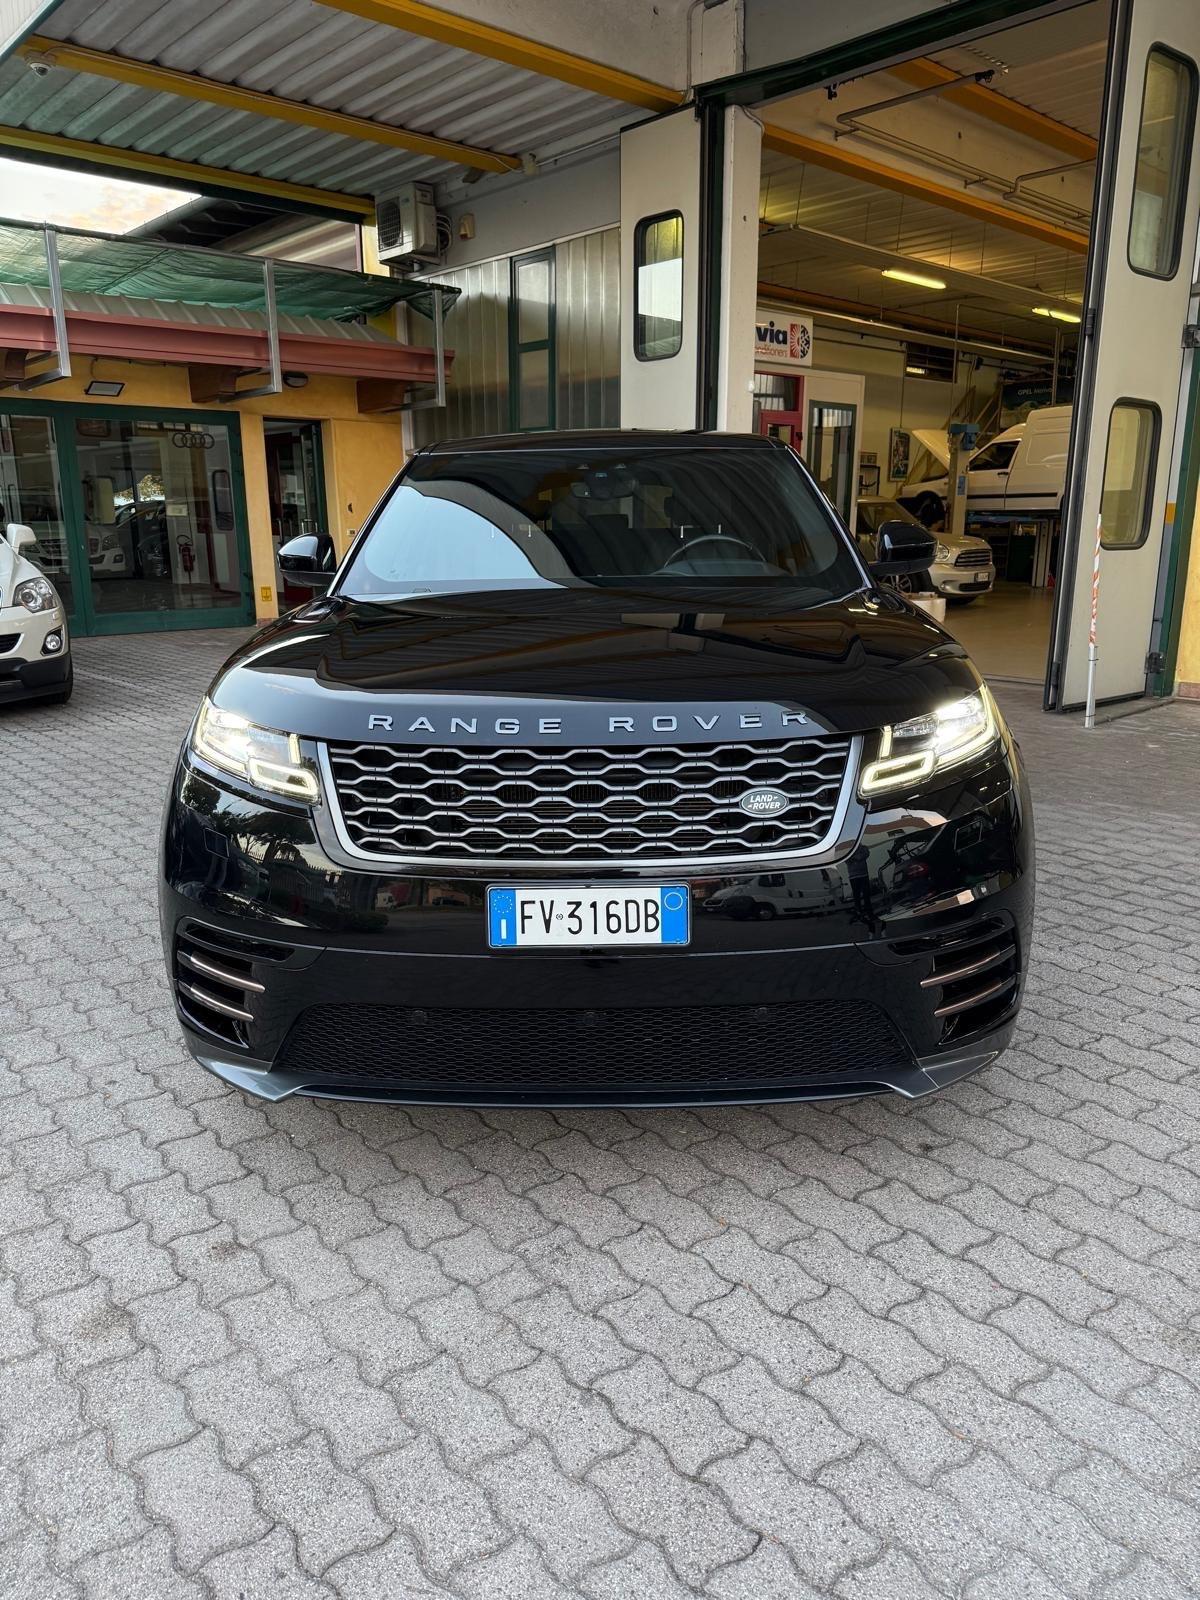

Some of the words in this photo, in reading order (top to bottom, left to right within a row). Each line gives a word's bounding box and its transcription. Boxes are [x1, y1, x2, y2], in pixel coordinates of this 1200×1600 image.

[755, 320, 788, 345] via
[368, 714, 563, 735] RANGE
[609, 710, 809, 733] ROVER
